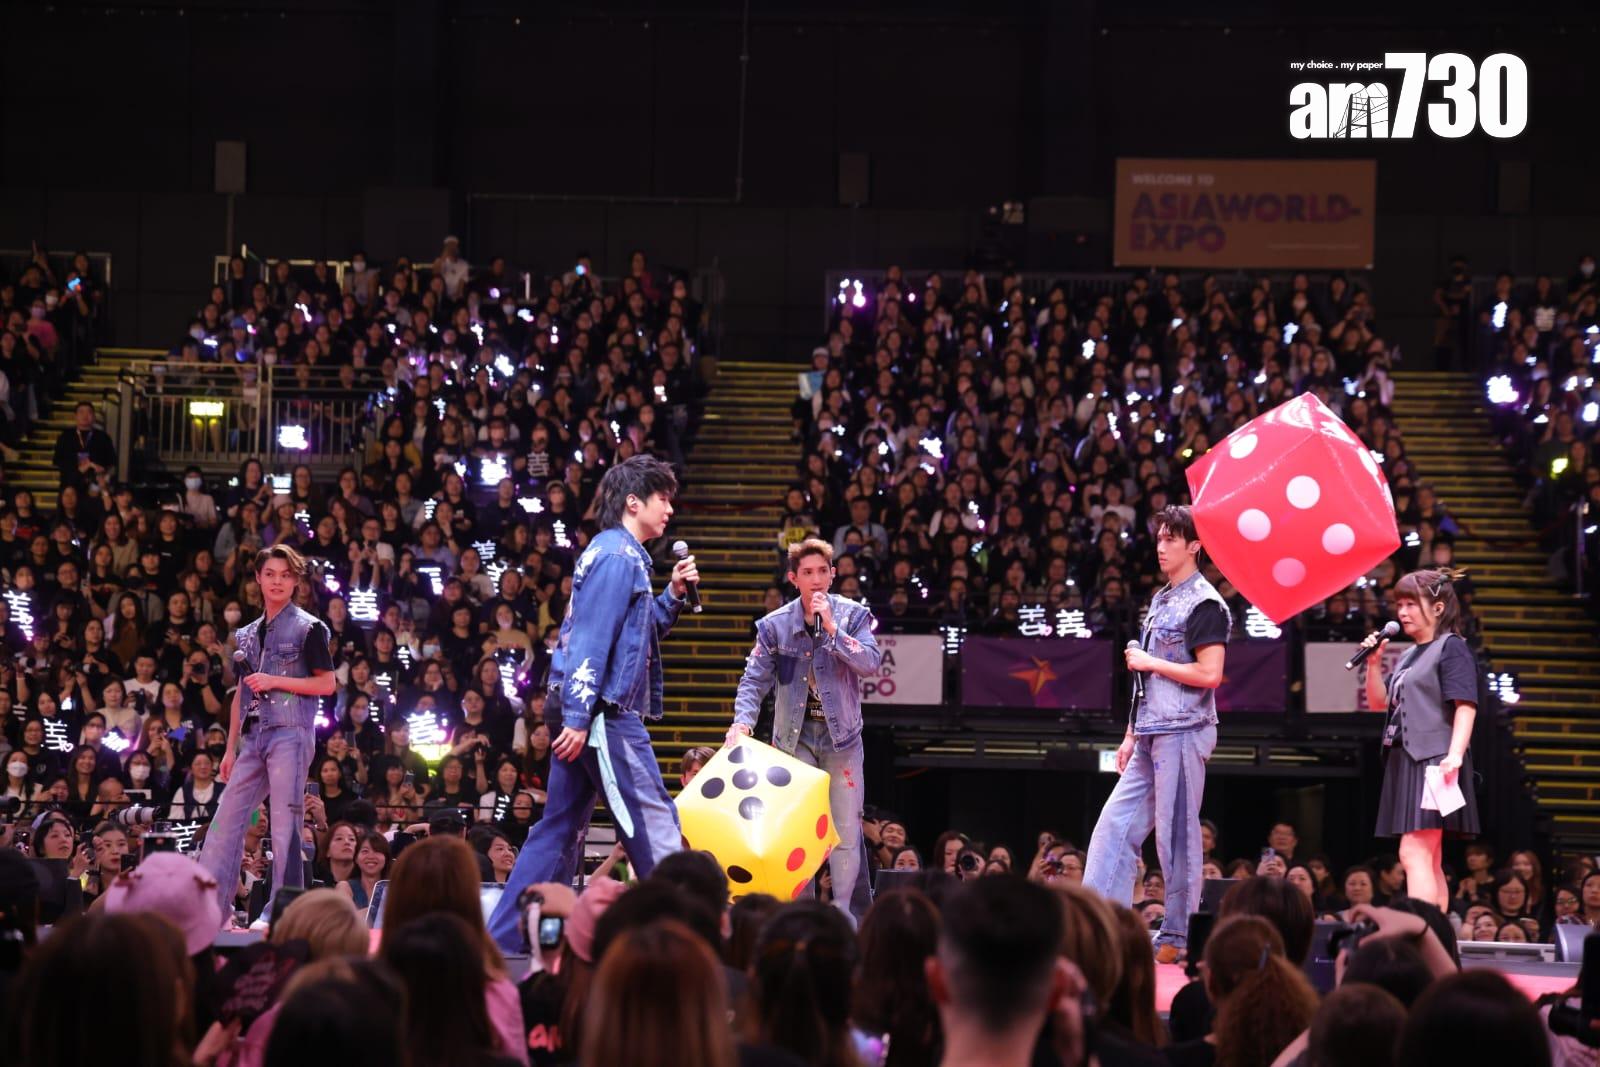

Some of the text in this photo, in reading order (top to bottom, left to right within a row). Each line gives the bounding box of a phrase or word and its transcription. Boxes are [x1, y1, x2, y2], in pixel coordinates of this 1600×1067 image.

[1132, 173, 1215, 185] WELCOME TO
[1131, 192, 1362, 222] ASIAWORLD-
[1130, 223, 1226, 253] EXPO
